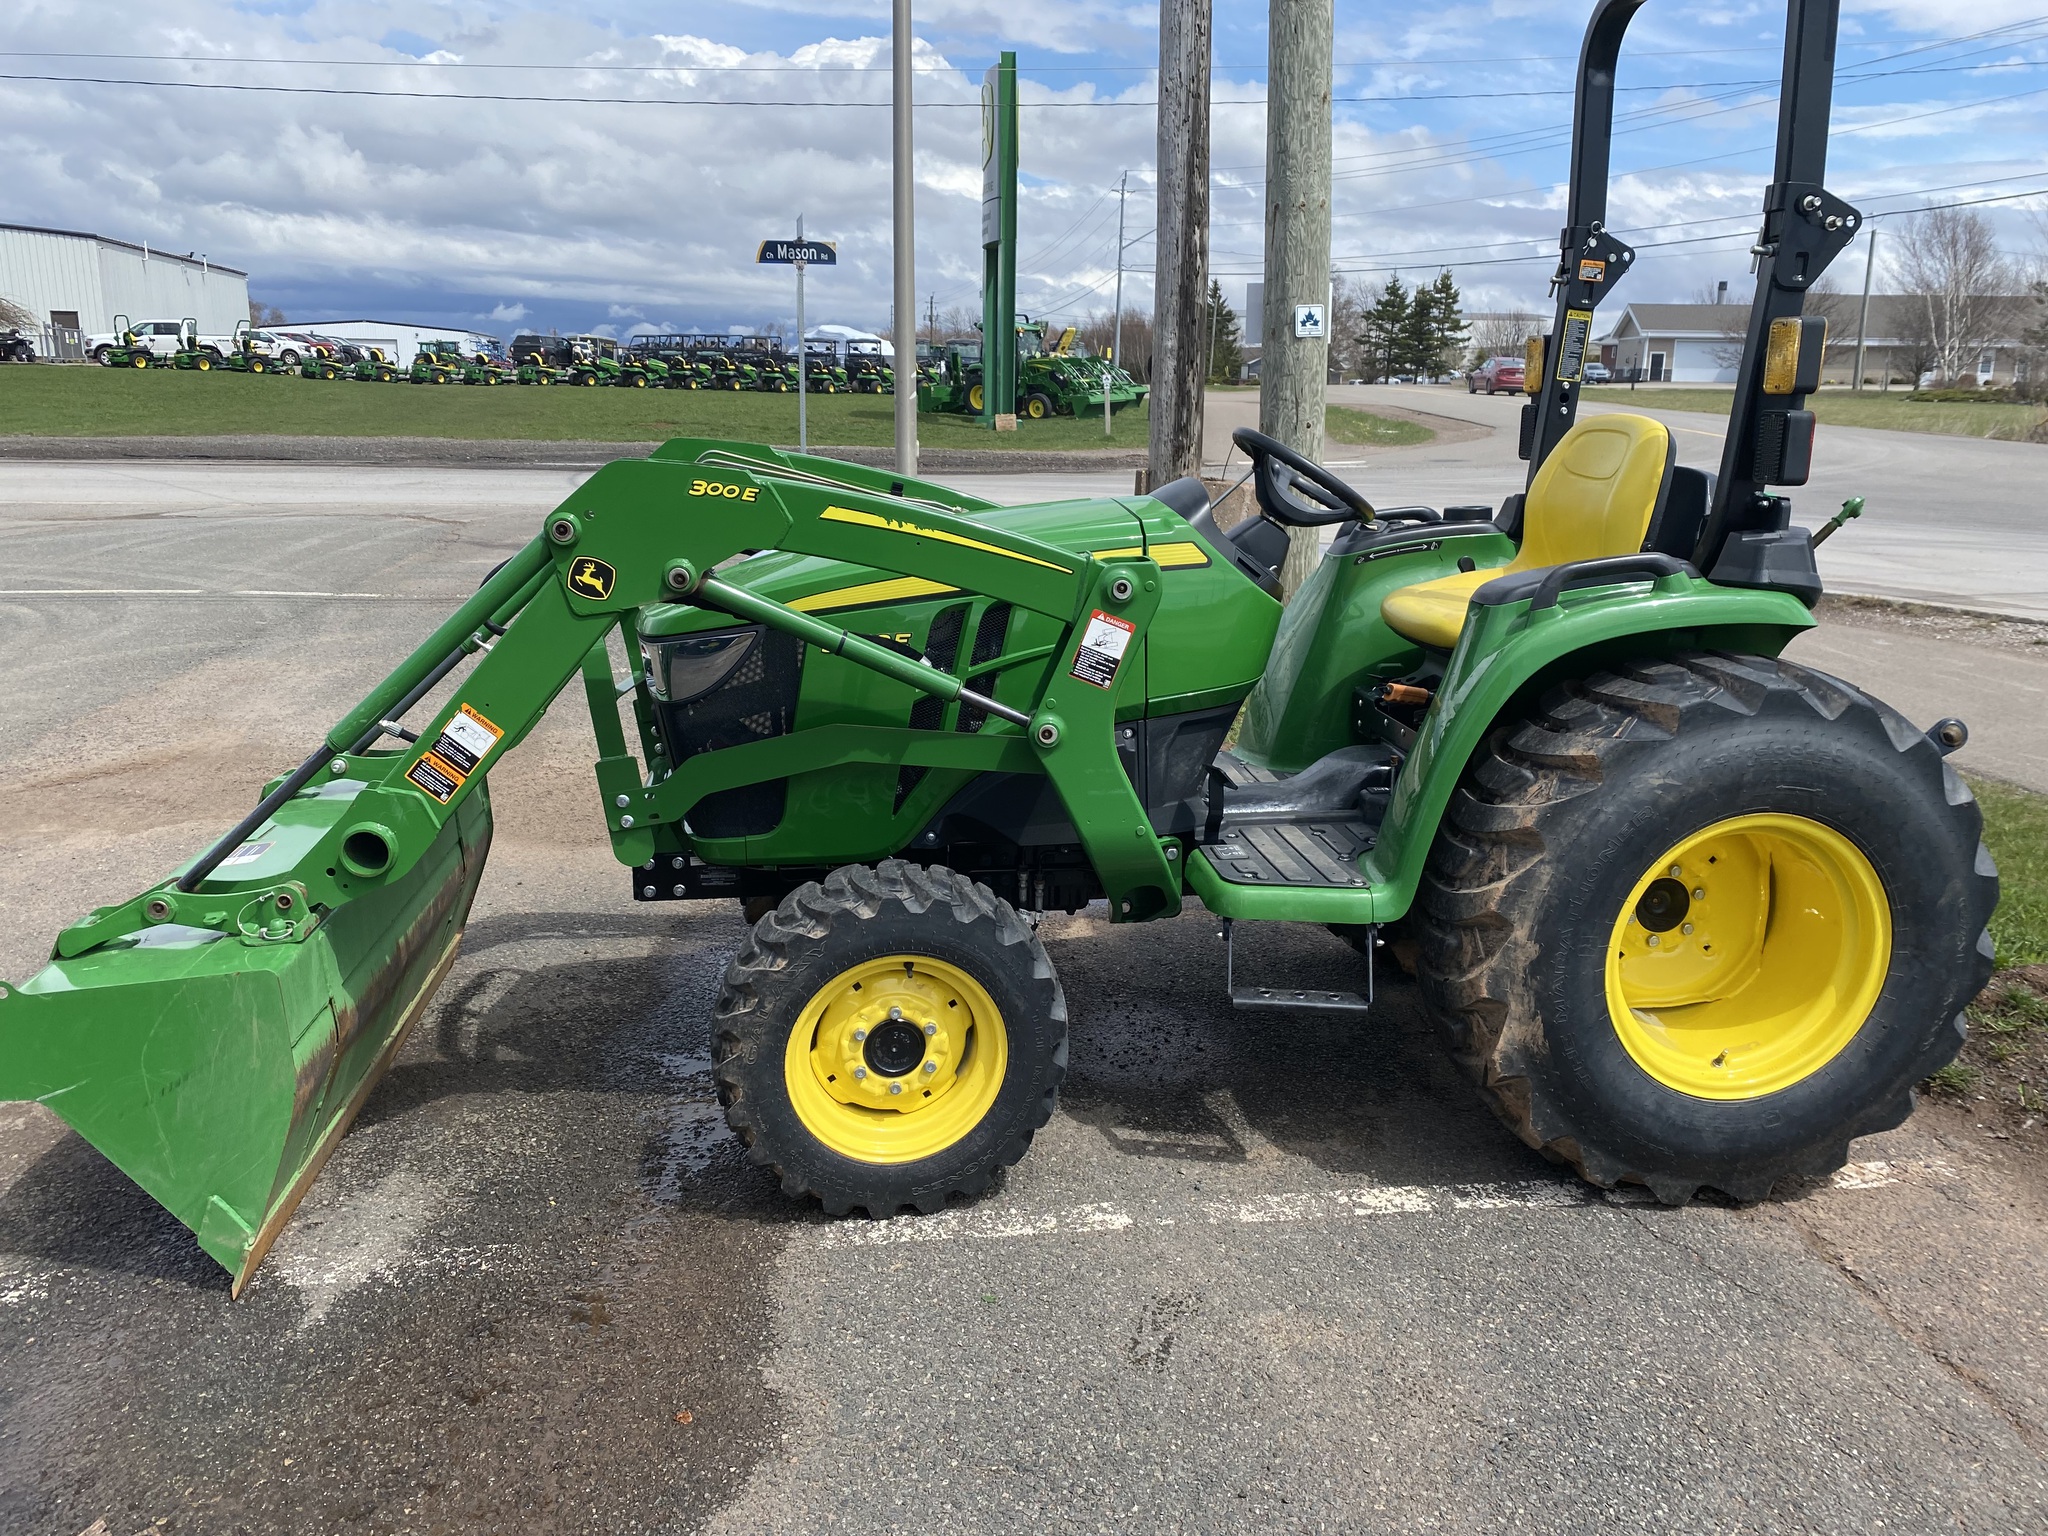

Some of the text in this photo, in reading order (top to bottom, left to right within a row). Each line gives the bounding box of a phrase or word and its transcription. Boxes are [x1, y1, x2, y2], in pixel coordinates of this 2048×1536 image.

[777, 244, 817, 260] Mason
[1105, 616, 1130, 630] DANGER
[472, 712, 498, 734] WARNING
[432, 760, 460, 782] WARNING
